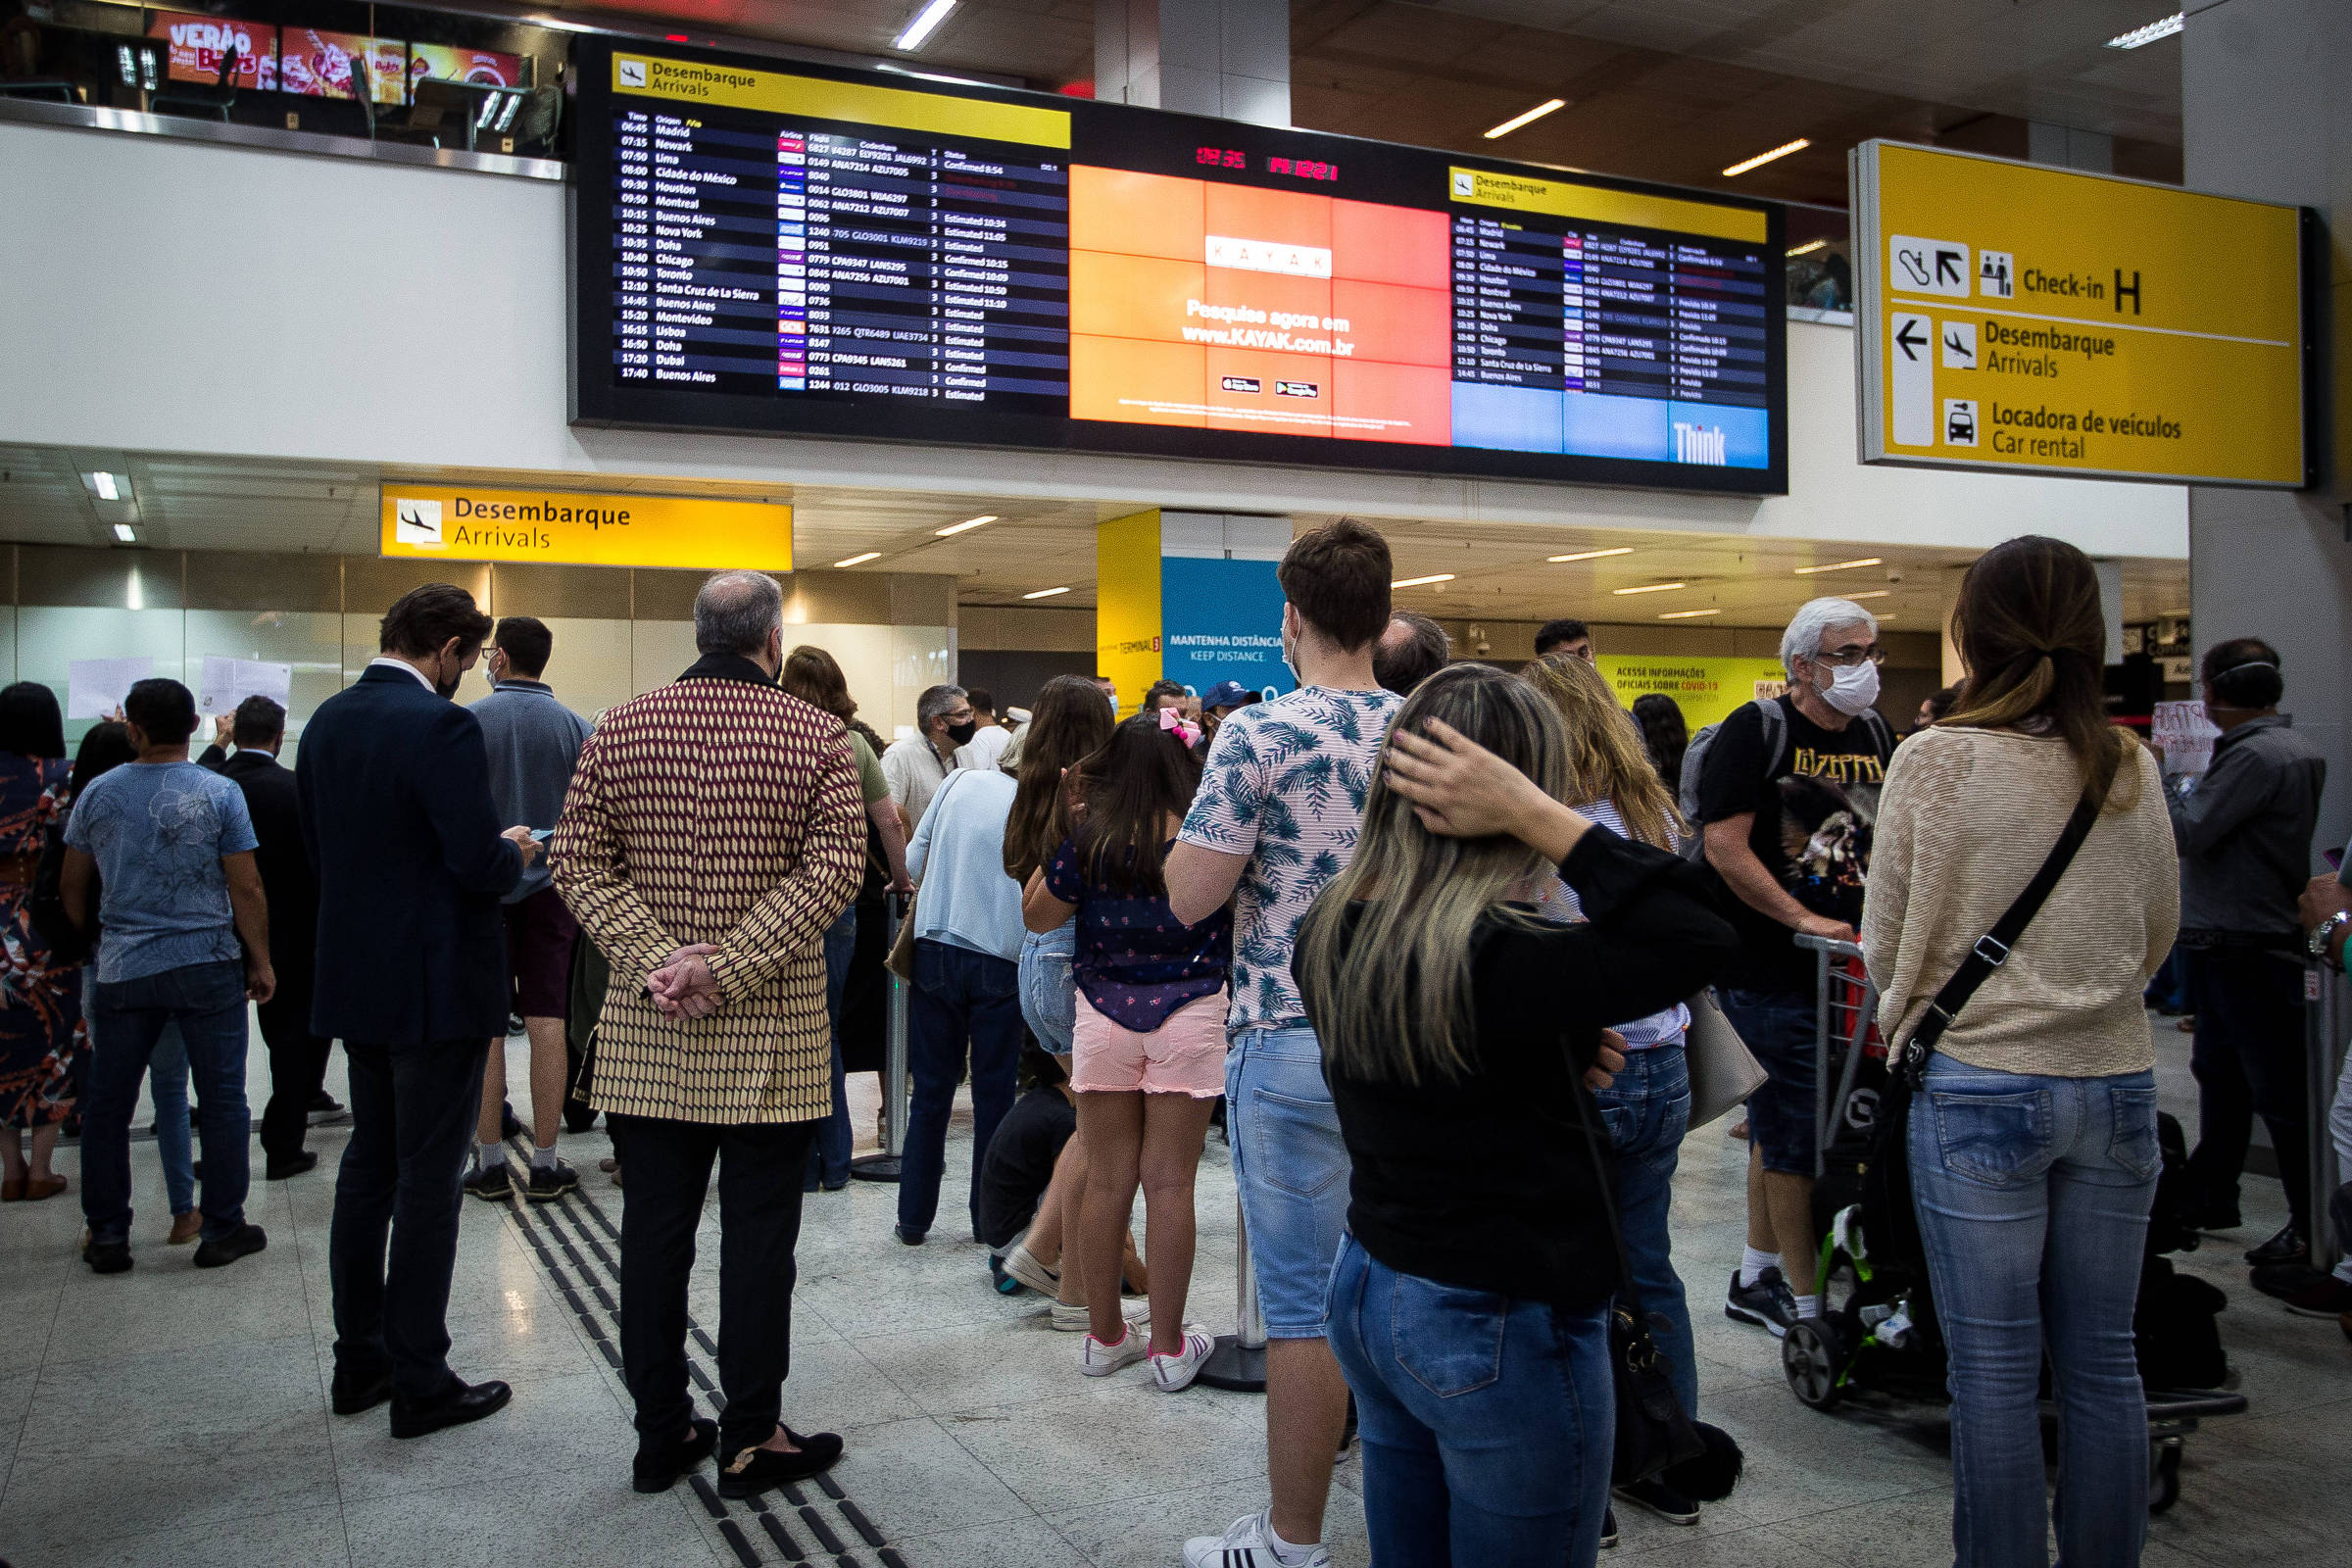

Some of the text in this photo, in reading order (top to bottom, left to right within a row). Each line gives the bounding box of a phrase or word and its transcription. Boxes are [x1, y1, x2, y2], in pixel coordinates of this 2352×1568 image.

[652, 62, 756, 89] Desembarque
[652, 77, 710, 97] Arrivals
[621, 136, 647, 147] 07:15
[656, 139, 692, 151] Newark
[621, 122, 648, 132] 06:45
[656, 124, 690, 137] Madrid
[944, 161, 982, 172] Confirmed
[621, 150, 648, 161] 07:50
[656, 153, 679, 165] Lima
[808, 134, 830, 144] Flight
[944, 151, 967, 160] Status
[621, 165, 648, 175] 08:00
[656, 168, 688, 179] Cidade
[689, 171, 703, 181] do
[703, 172, 737, 184] México
[1476, 175, 1546, 196] Desembarque
[621, 179, 648, 190] 09:30
[656, 181, 696, 194] Houston
[945, 215, 983, 225] Estimated
[1476, 188, 1514, 203] Arrivals
[621, 193, 648, 204] 09:50
[656, 196, 699, 209] Montreal
[945, 227, 983, 239] Estimated
[622, 209, 648, 220] 10:15
[656, 211, 691, 223] Buenos
[692, 215, 715, 225] Aires
[945, 241, 984, 253] Estimated
[622, 223, 648, 233] 10:25
[656, 225, 680, 236] Nova
[681, 227, 702, 238] York
[945, 255, 985, 266] Confirmed
[622, 237, 648, 248] 10:35
[656, 239, 681, 251] Doha
[945, 269, 986, 279] Confirmed
[1214, 245, 1323, 269] KAYAK
[622, 252, 648, 263] 10:40
[657, 254, 694, 268] Chicago
[945, 281, 982, 293] Estimated
[622, 266, 648, 277] 10:50
[657, 268, 693, 280] Toronto
[945, 295, 982, 306] Estimated
[622, 280, 648, 291] 12:10
[657, 282, 683, 294] Santa
[684, 285, 707, 296] Cruz
[707, 287, 719, 297] de
[720, 288, 731, 298] La
[733, 289, 760, 300] Sierra
[945, 309, 984, 319] Estimated
[2023, 269, 2141, 316] Check-in H
[622, 296, 648, 306] 14:45
[657, 297, 691, 309] Buenos
[692, 301, 715, 312] Aires
[945, 320, 984, 333] Estimated
[622, 310, 648, 320] 15:20
[657, 312, 712, 324] Montevideo
[945, 336, 984, 347] Estimated
[1187, 298, 1349, 332] Pesquise agora em
[622, 324, 648, 335] 16:15
[657, 325, 686, 337] Lisboa
[944, 347, 984, 361] Estimated
[622, 339, 648, 349] 16:50
[657, 340, 682, 351] Doha
[945, 363, 986, 374] Confirmed
[1182, 326, 1355, 356] www.KAYAK.com.br
[1985, 320, 2115, 361] Desembarque
[622, 353, 648, 364] 17:20
[656, 355, 684, 366] Dubai
[945, 376, 987, 387] Confirmed
[1986, 350, 2058, 378] Arrivals
[622, 368, 648, 378] 17:40
[657, 368, 691, 380] Buenos
[692, 371, 715, 382] Aires
[946, 390, 984, 401] Estimated
[1992, 401, 2181, 439] Locadora de veículos
[1674, 421, 1726, 466] Think
[1992, 429, 2085, 459] Car rental
[455, 497, 630, 530] Desembarque
[455, 525, 550, 548] Arrivals
[1170, 634, 1283, 648] MANTENHA DISTÂNCIA
[1191, 651, 1264, 662] KEEP DISTANCE
[1617, 666, 1705, 680] ACESSE INFORMAÇÕES
[1617, 679, 1718, 691] OFICIAIS SOBRE COVID-19
